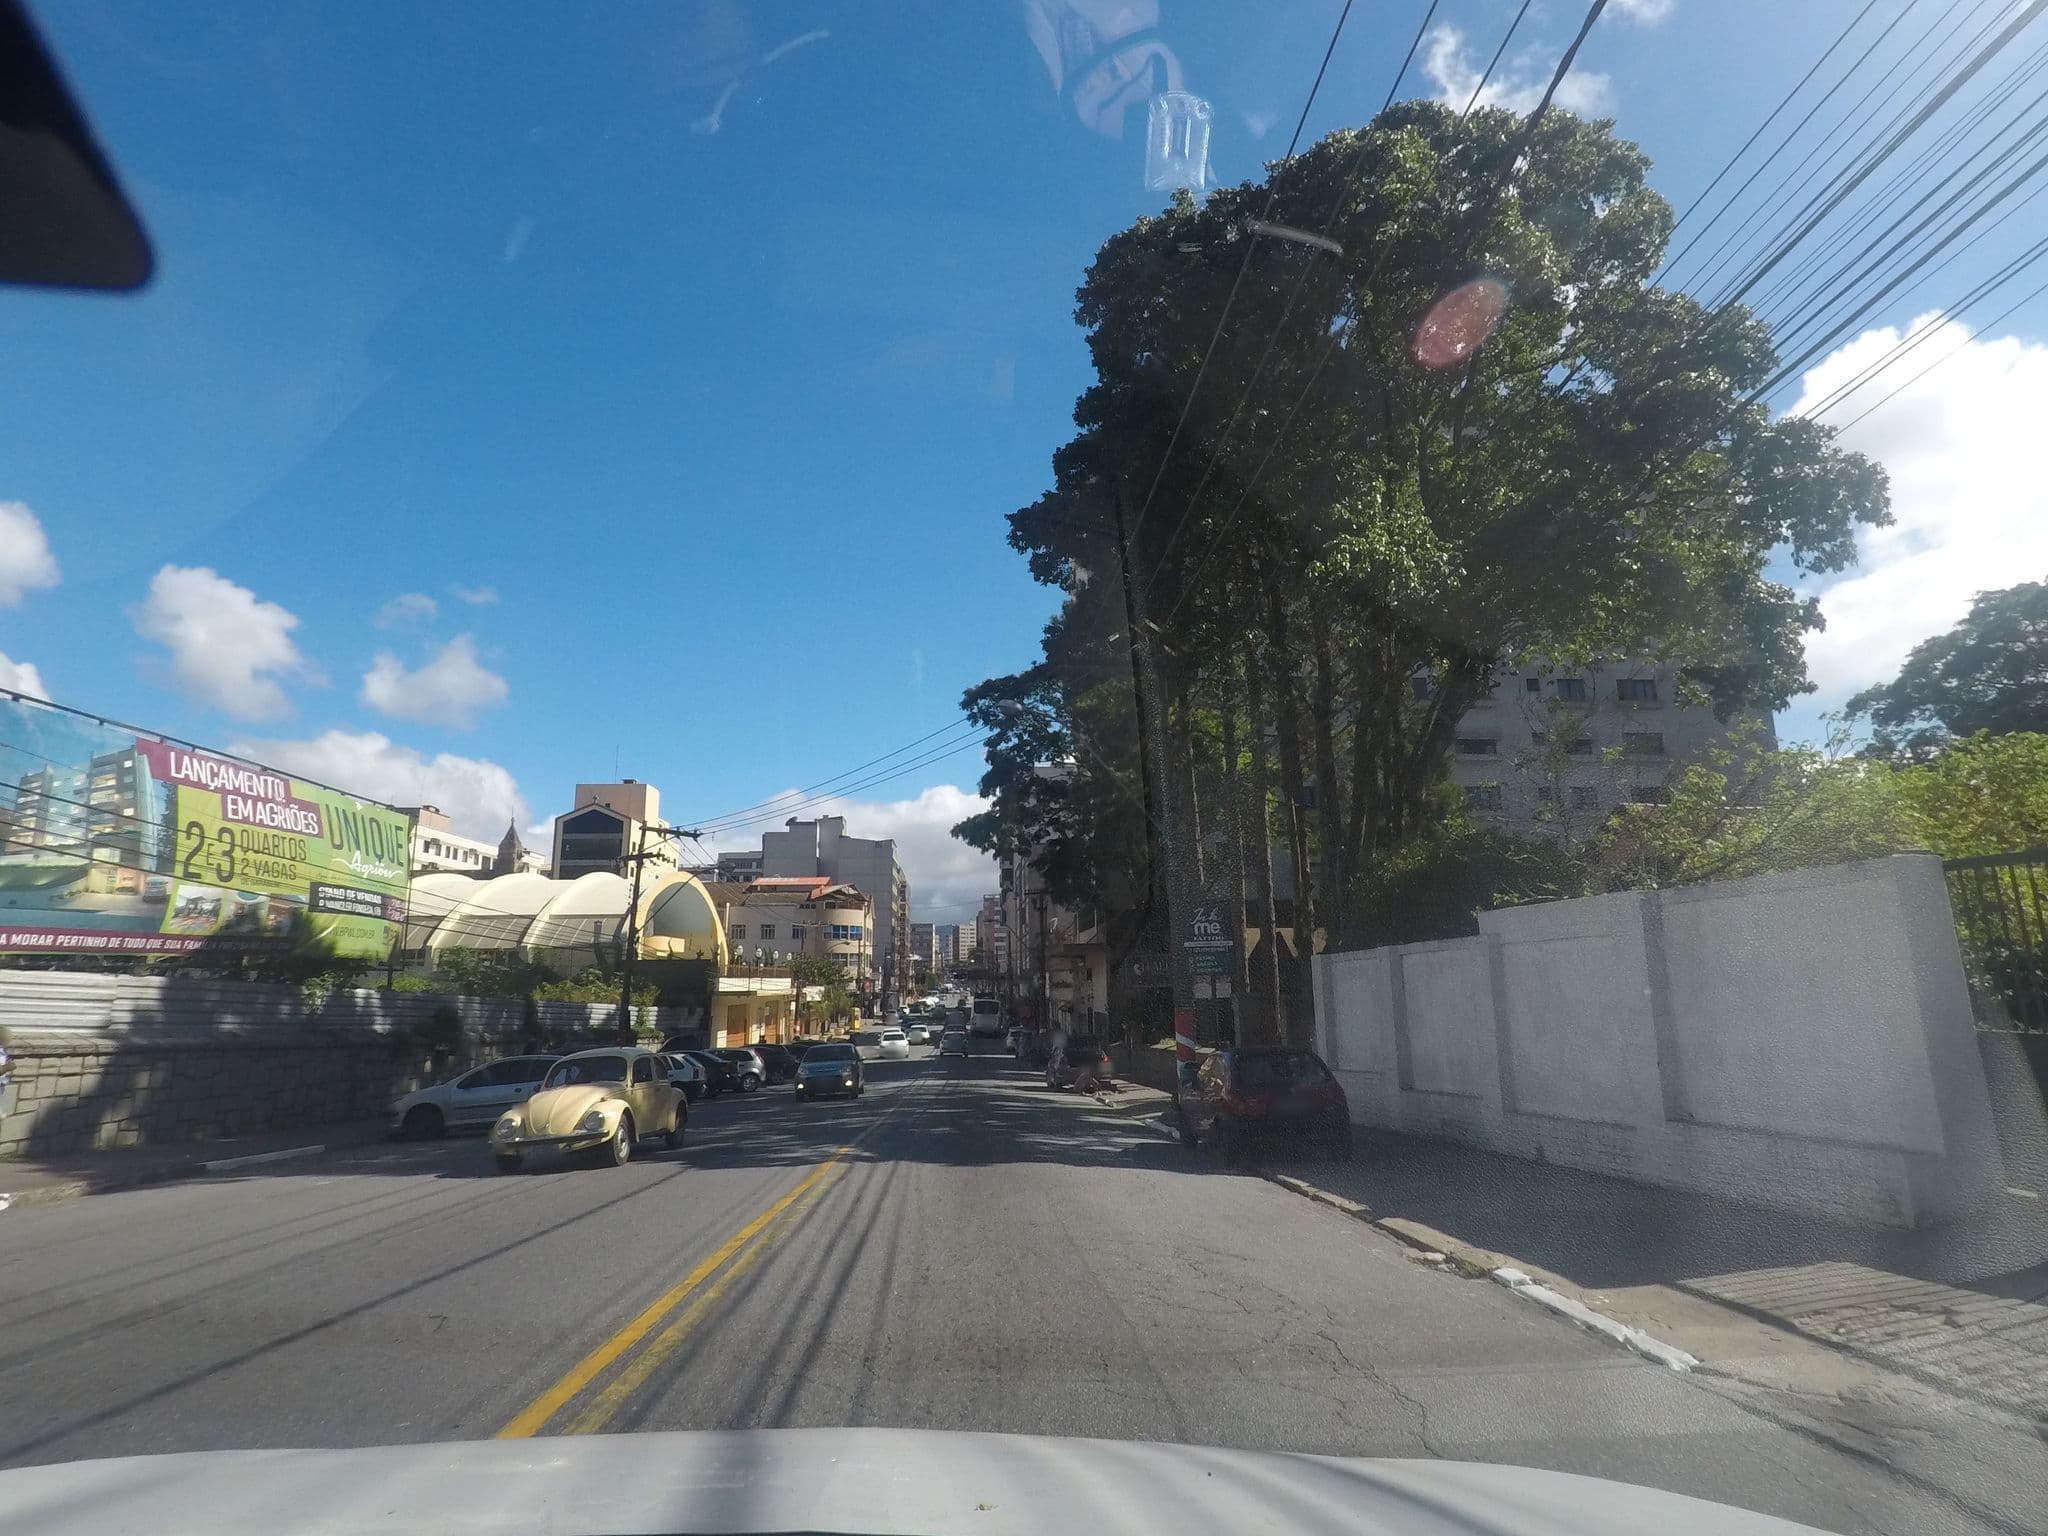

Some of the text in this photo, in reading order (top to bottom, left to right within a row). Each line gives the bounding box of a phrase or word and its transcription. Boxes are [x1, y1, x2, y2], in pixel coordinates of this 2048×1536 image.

[170, 751, 286, 802] LANÇAMENTO!
[227, 794, 319, 835] EM AGRIÕES
[183, 820, 235, 883] 2 E 3
[240, 829, 307, 861] QUARTOS
[325, 803, 404, 867] UNIQUE
[240, 857, 297, 881] 2 VAGAS
[10, 933, 54, 946] MORAR
[56, 935, 109, 948] PERTINHO
[109, 937, 121, 948] DE
[122, 938, 145, 949] TUDO
[1194, 922, 1221, 936] me
